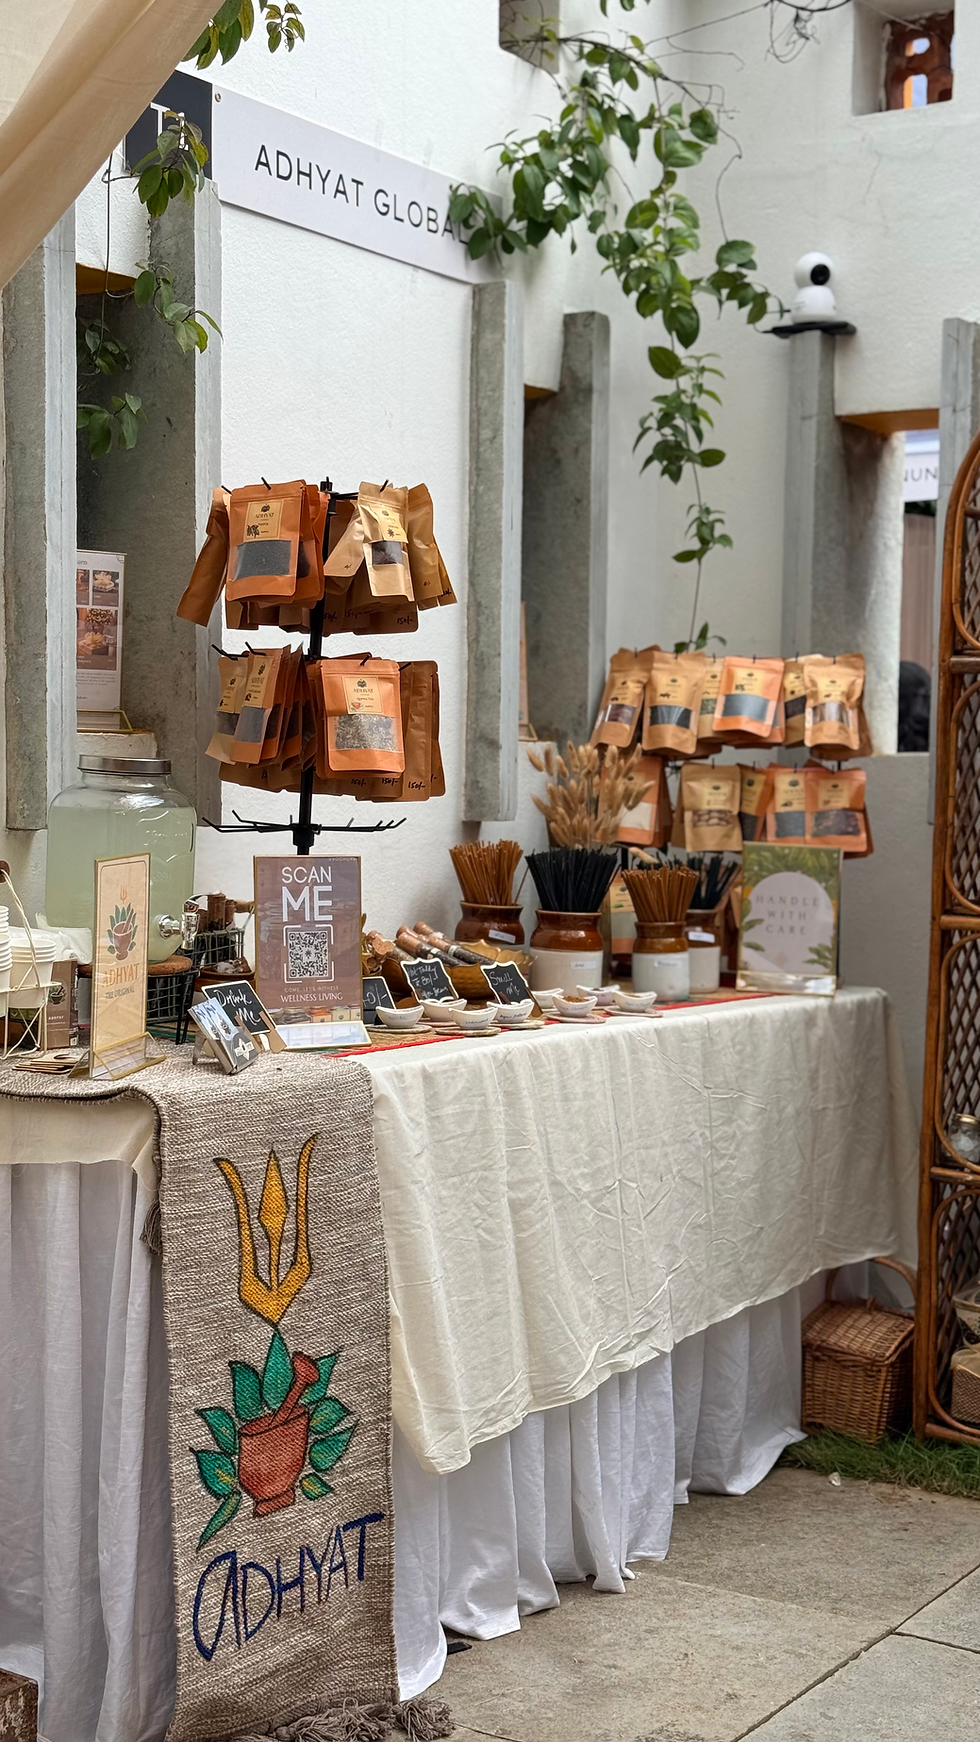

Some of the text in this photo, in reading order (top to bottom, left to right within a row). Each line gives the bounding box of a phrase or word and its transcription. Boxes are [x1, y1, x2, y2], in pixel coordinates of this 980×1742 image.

[253, 143, 365, 208] ADHYAT
[396, 615, 413, 625] 150/-
[381, 777, 399, 787] 150/-
[407, 781, 426, 791] 150/-
[281, 865, 332, 884] SCAN
[281, 885, 333, 922] ME
[755, 894, 819, 907] HANDLE
[766, 909, 807, 921] WITH
[765, 924, 806, 936] CARE
[102, 962, 140, 988] ADHYAT
[213, 988, 253, 1007] Drink
[280, 992, 344, 1003] WELLNESS LIVING
